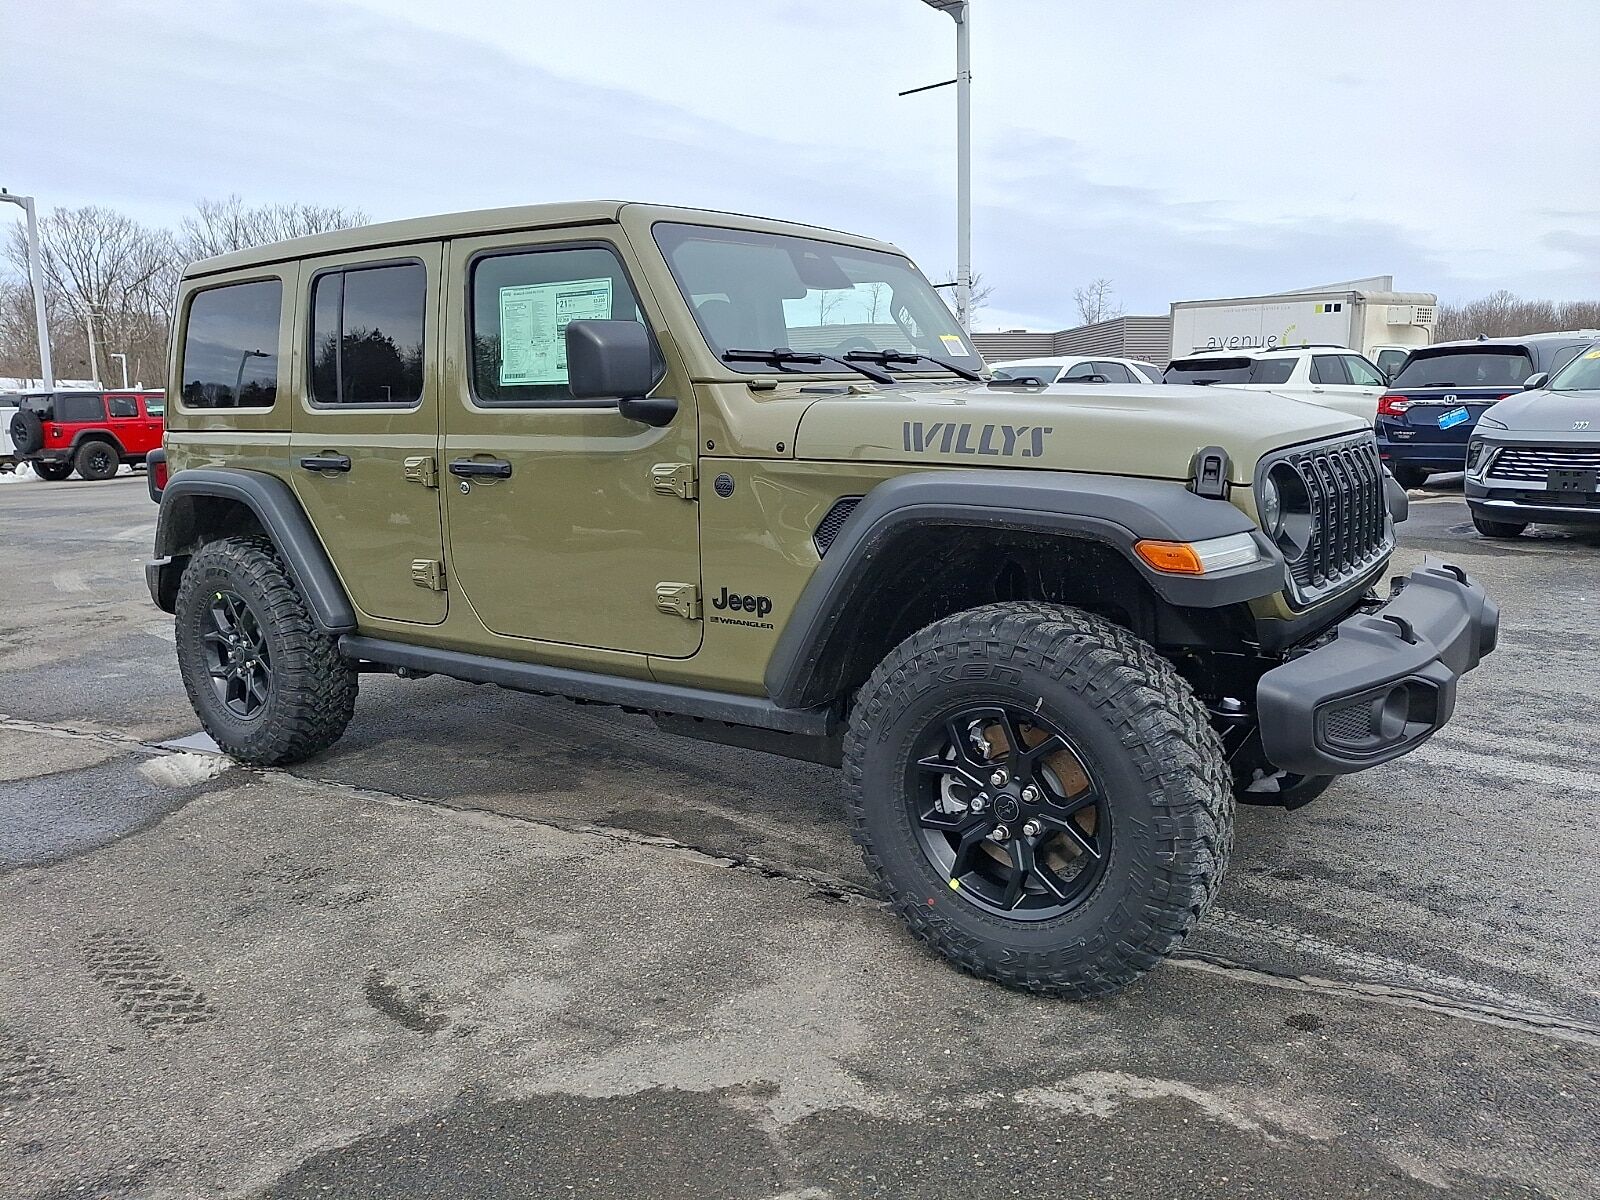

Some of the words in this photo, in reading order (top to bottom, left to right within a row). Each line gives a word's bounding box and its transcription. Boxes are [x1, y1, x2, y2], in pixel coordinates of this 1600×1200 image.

[1206, 334, 1278, 349] avenue
[903, 421, 1053, 458] WILLYS
[712, 586, 773, 618] Jeep
[719, 617, 774, 630] WRANGLER
[876, 661, 1023, 745] FALKEN
